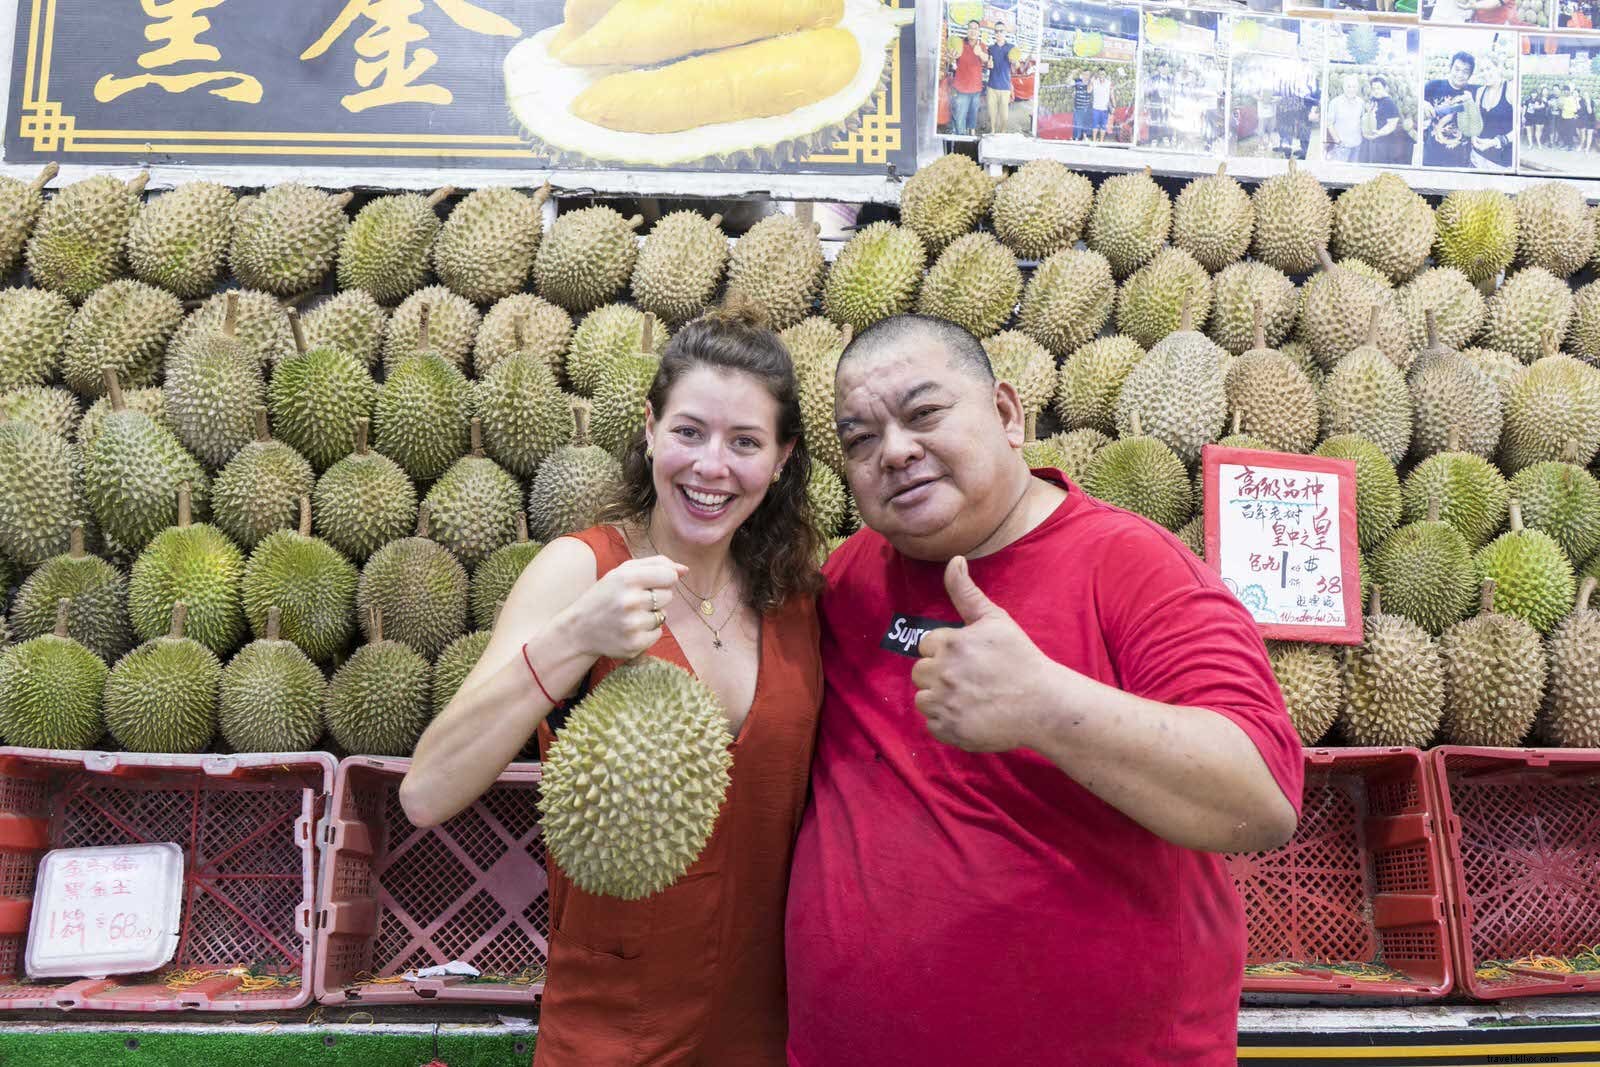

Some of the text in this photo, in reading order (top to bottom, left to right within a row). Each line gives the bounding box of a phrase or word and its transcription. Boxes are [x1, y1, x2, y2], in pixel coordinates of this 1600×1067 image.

[1304, 555, 1319, 573] $
[1316, 576, 1341, 594] 38
[1280, 609, 1326, 624] Wonderful
